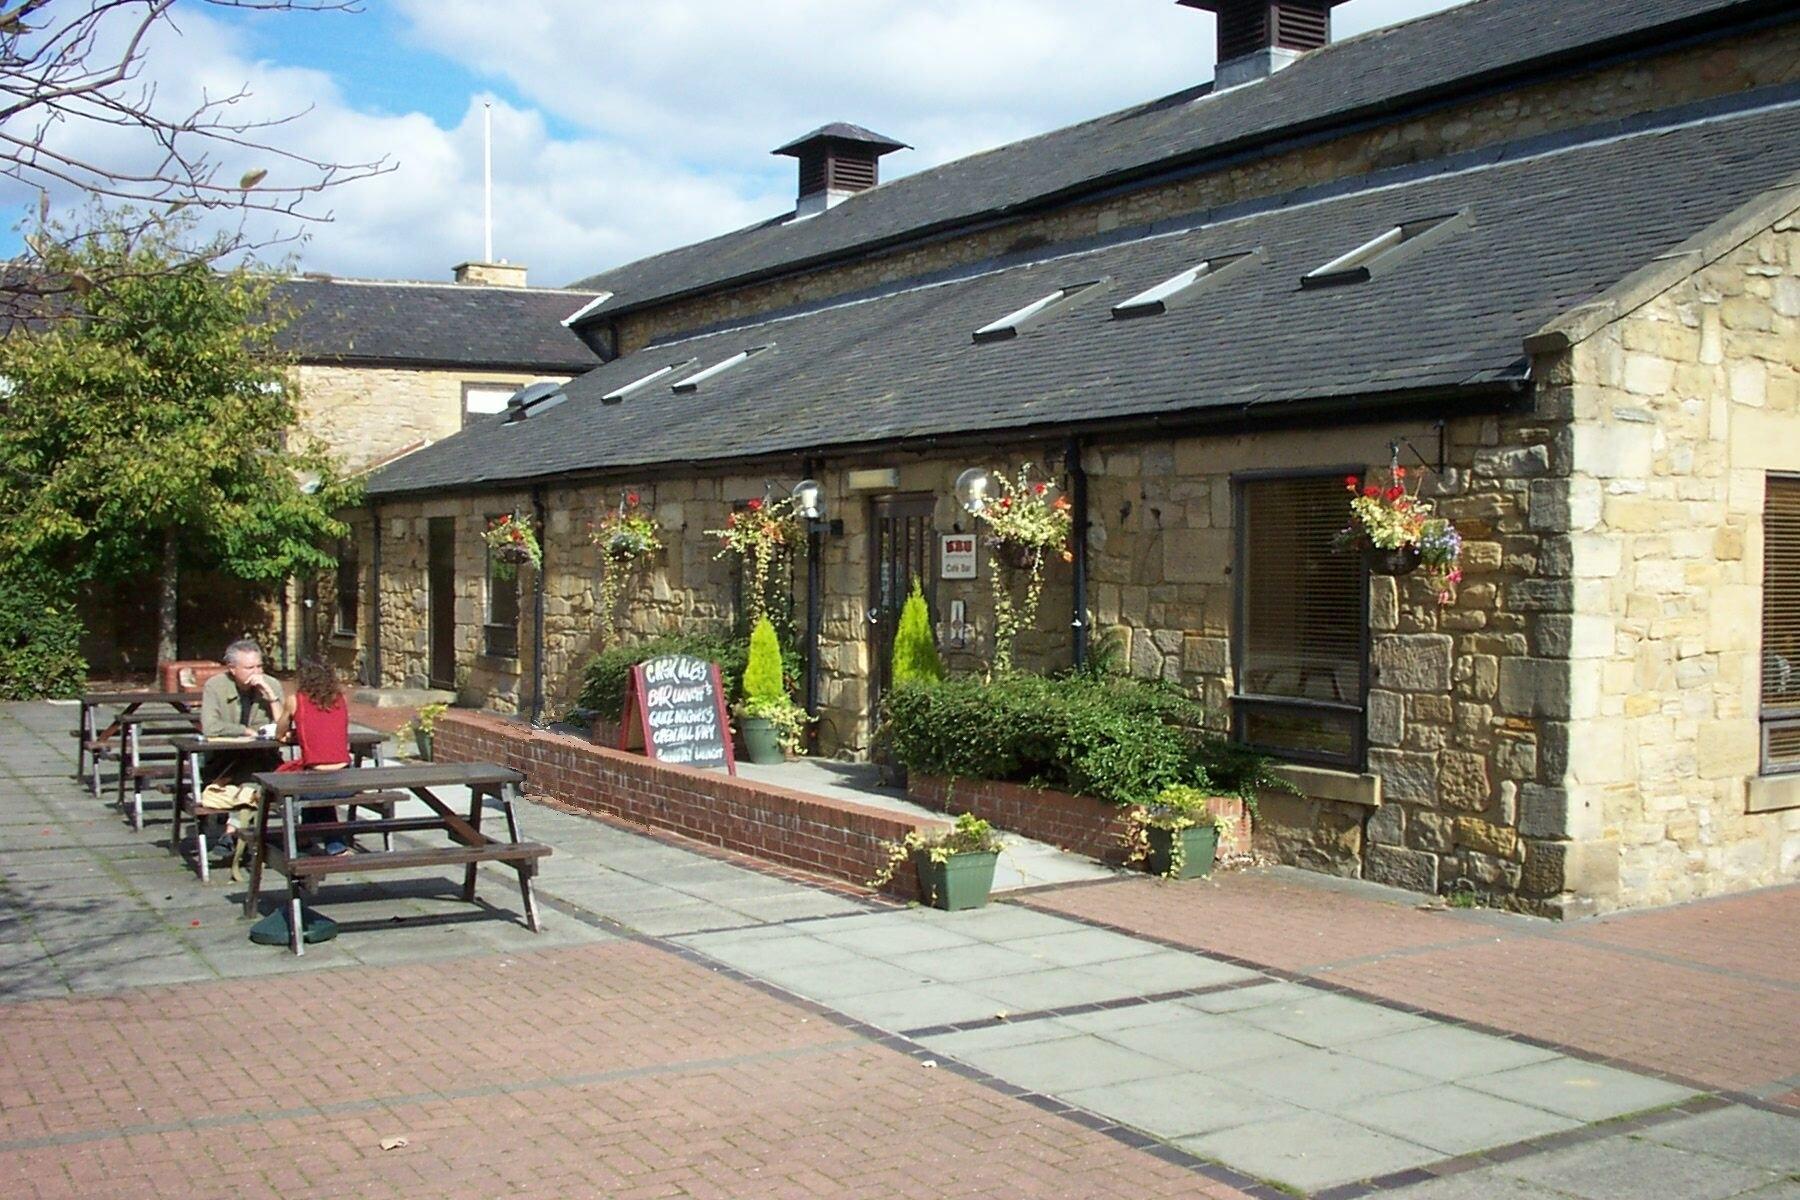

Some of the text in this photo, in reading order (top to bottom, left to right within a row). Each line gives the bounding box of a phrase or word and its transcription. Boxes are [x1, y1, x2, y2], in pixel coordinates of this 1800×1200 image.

[646, 657, 707, 684] CASK ALES
[647, 684, 674, 708] BAR
[653, 724, 715, 744] OPEN ALL DAY
